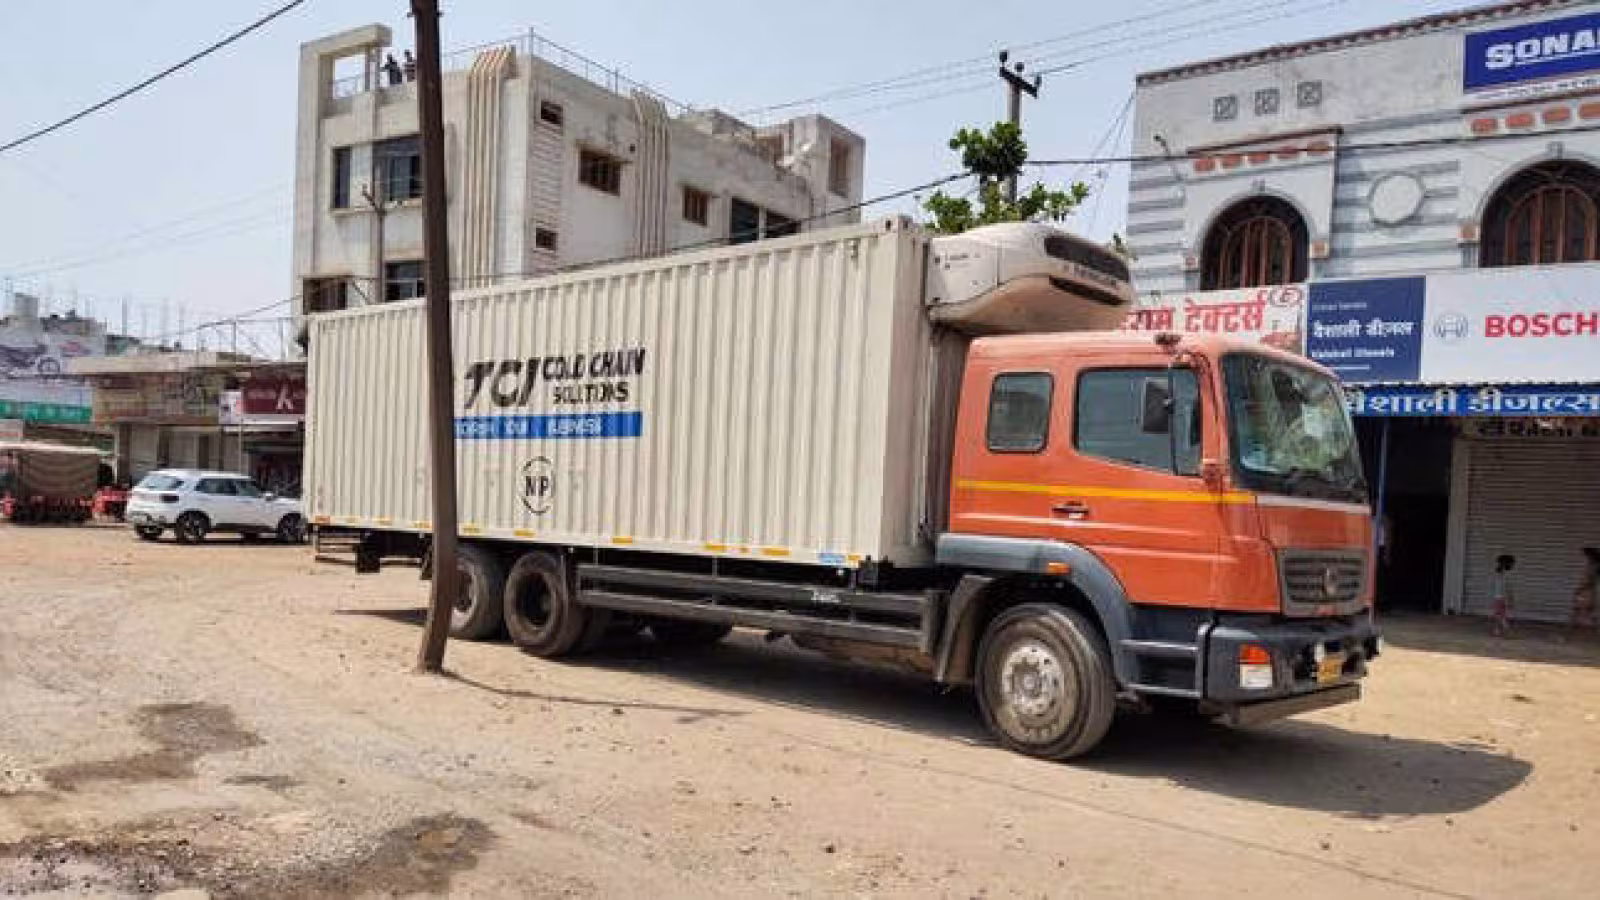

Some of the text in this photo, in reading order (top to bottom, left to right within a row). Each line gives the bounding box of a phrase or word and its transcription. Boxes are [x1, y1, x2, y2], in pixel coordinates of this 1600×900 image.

[1485, 27, 1600, 70] SONA
[1485, 312, 1597, 337] BOSCH
[464, 357, 541, 409] TCI
